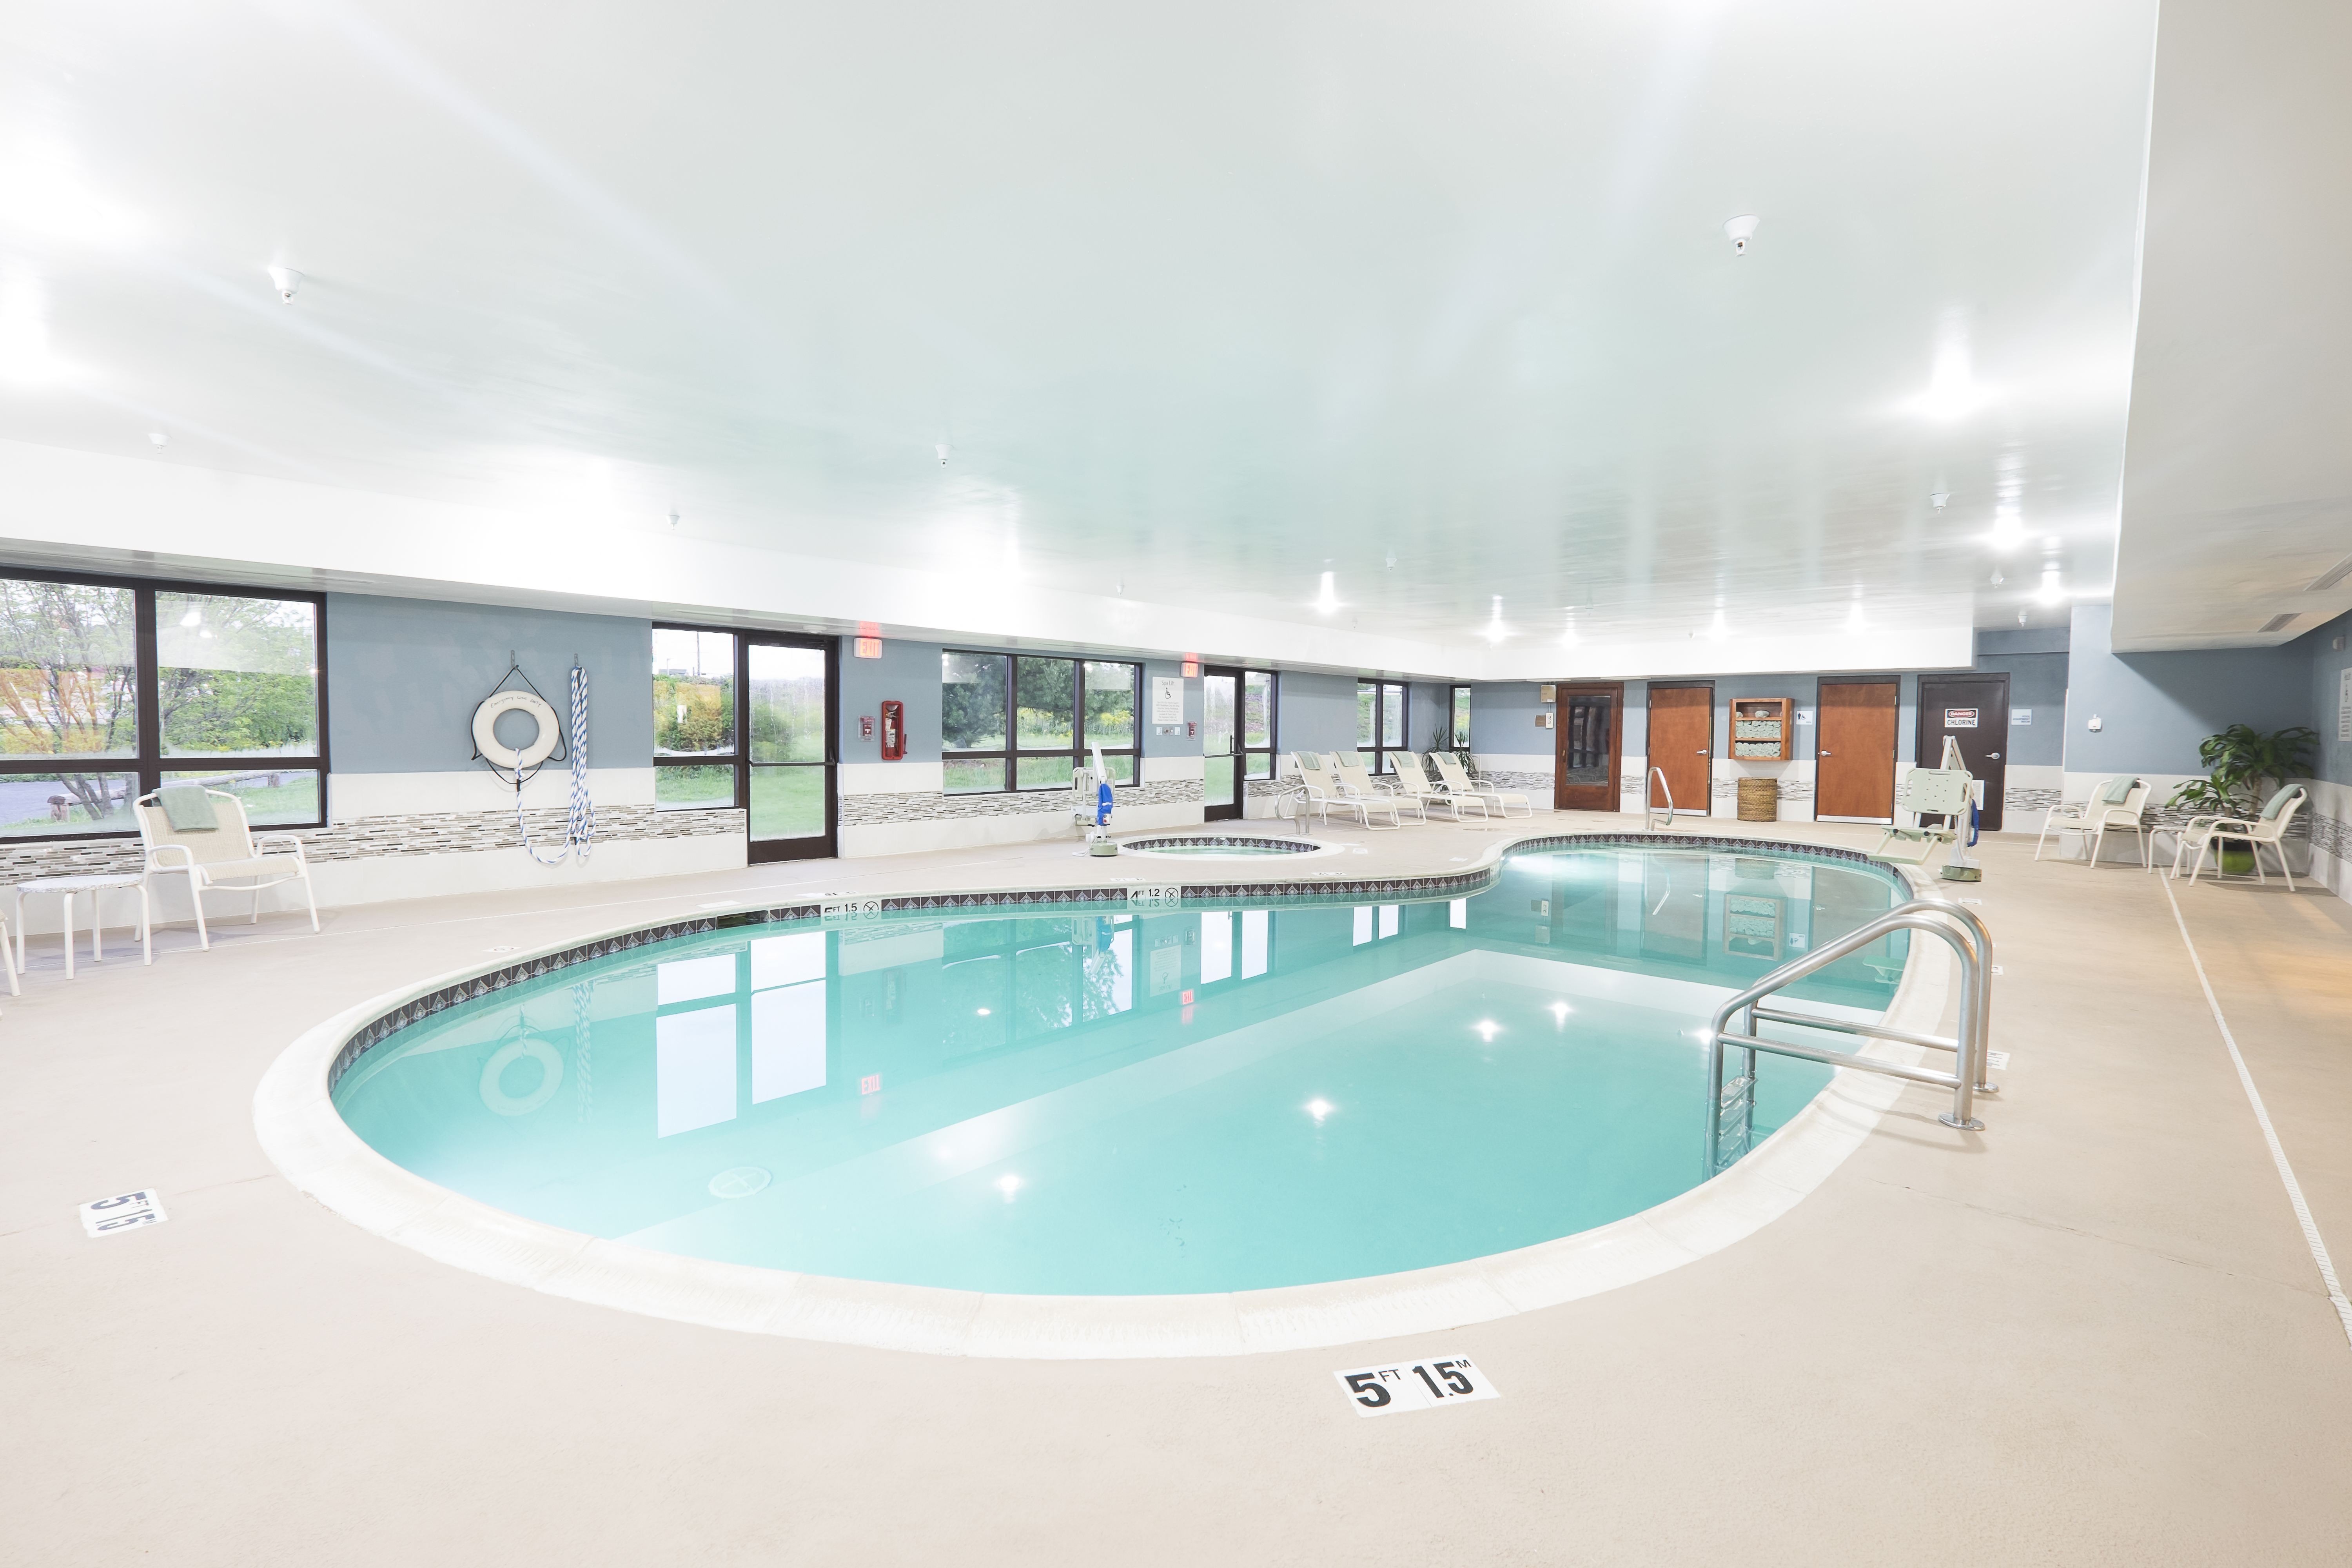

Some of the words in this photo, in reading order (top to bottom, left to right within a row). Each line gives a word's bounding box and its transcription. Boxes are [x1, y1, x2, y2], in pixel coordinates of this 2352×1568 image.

[860, 639, 879, 656] EXIT
[1185, 663, 1197, 676] EXIT
[1149, 889, 1160, 897] 1.2
[845, 903, 857, 912] 1.5
